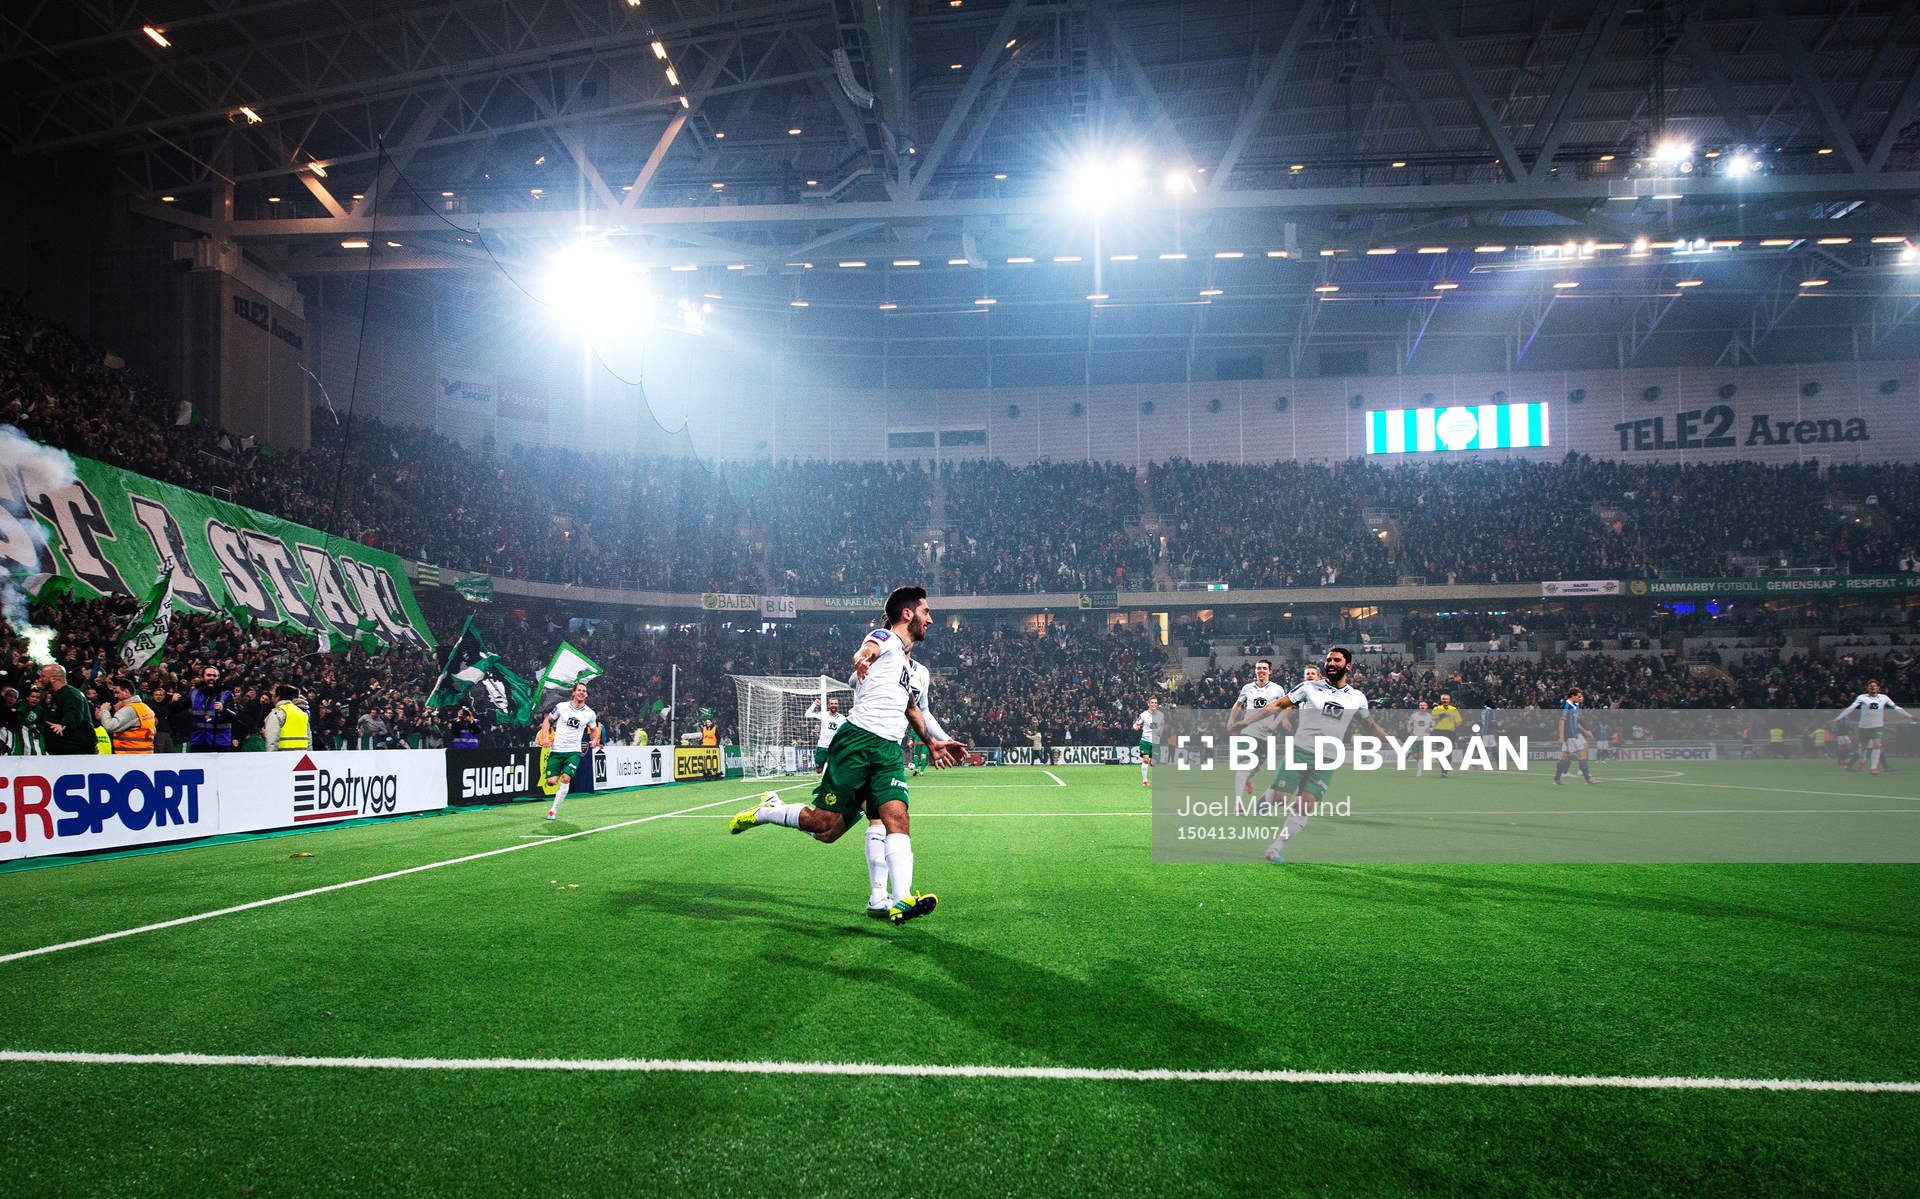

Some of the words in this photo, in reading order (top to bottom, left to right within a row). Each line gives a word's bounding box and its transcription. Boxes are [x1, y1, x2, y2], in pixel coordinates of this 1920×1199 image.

[1614, 404, 1736, 451] TELE2
[1744, 414, 1870, 446] Arena
[1651, 581, 1715, 592] HAMMARBY
[1766, 579, 1836, 590] GEMENSKAP
[1846, 578, 1897, 588] RESPEKT
[717, 594, 757, 609] BAJEN
[1618, 748, 1712, 760] NTERSPORT
[462, 753, 530, 798] swedol
[319, 768, 398, 815] Botrygg
